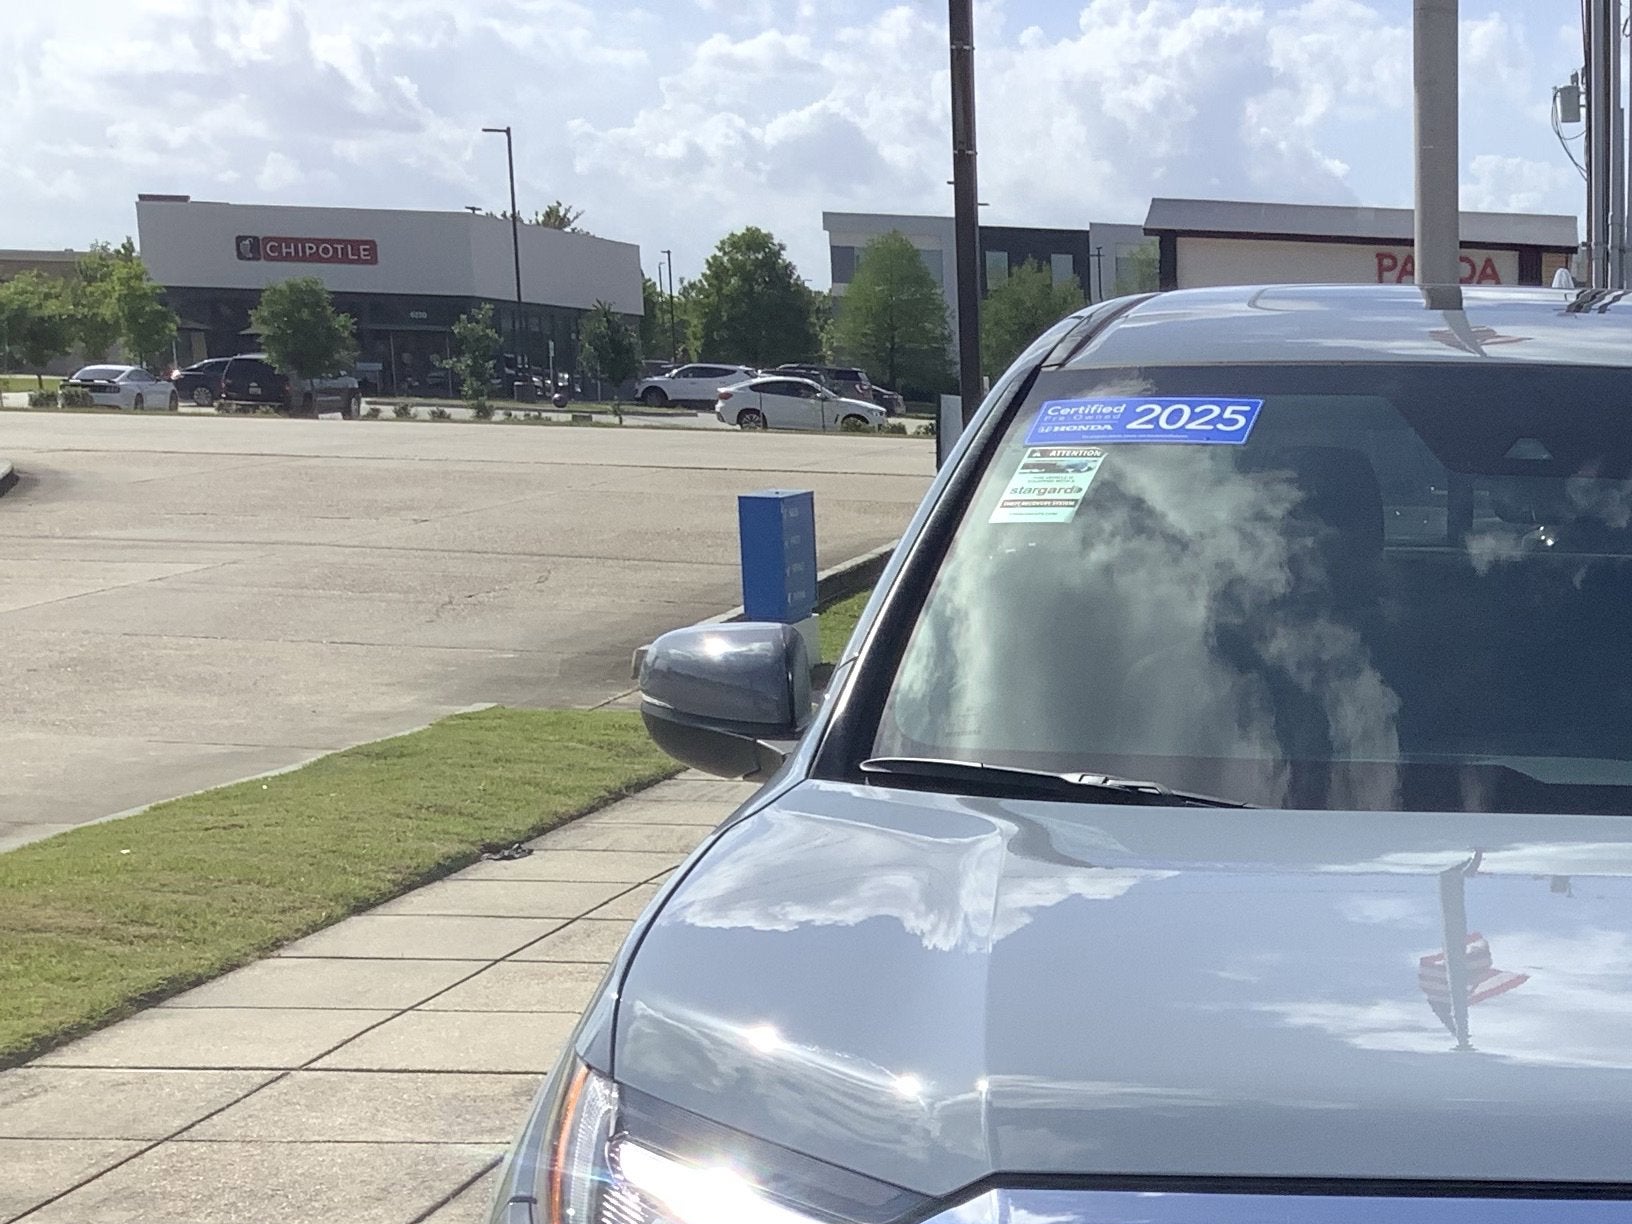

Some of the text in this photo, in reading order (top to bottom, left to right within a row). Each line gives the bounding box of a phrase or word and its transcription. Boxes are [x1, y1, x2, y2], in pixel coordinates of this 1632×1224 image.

[265, 241, 372, 260] CHIPOTLE
[1375, 252, 1502, 285] PADA
[1047, 404, 1127, 417] Certified
[1125, 404, 1251, 432] 2025
[1052, 424, 1113, 432] HONDA
